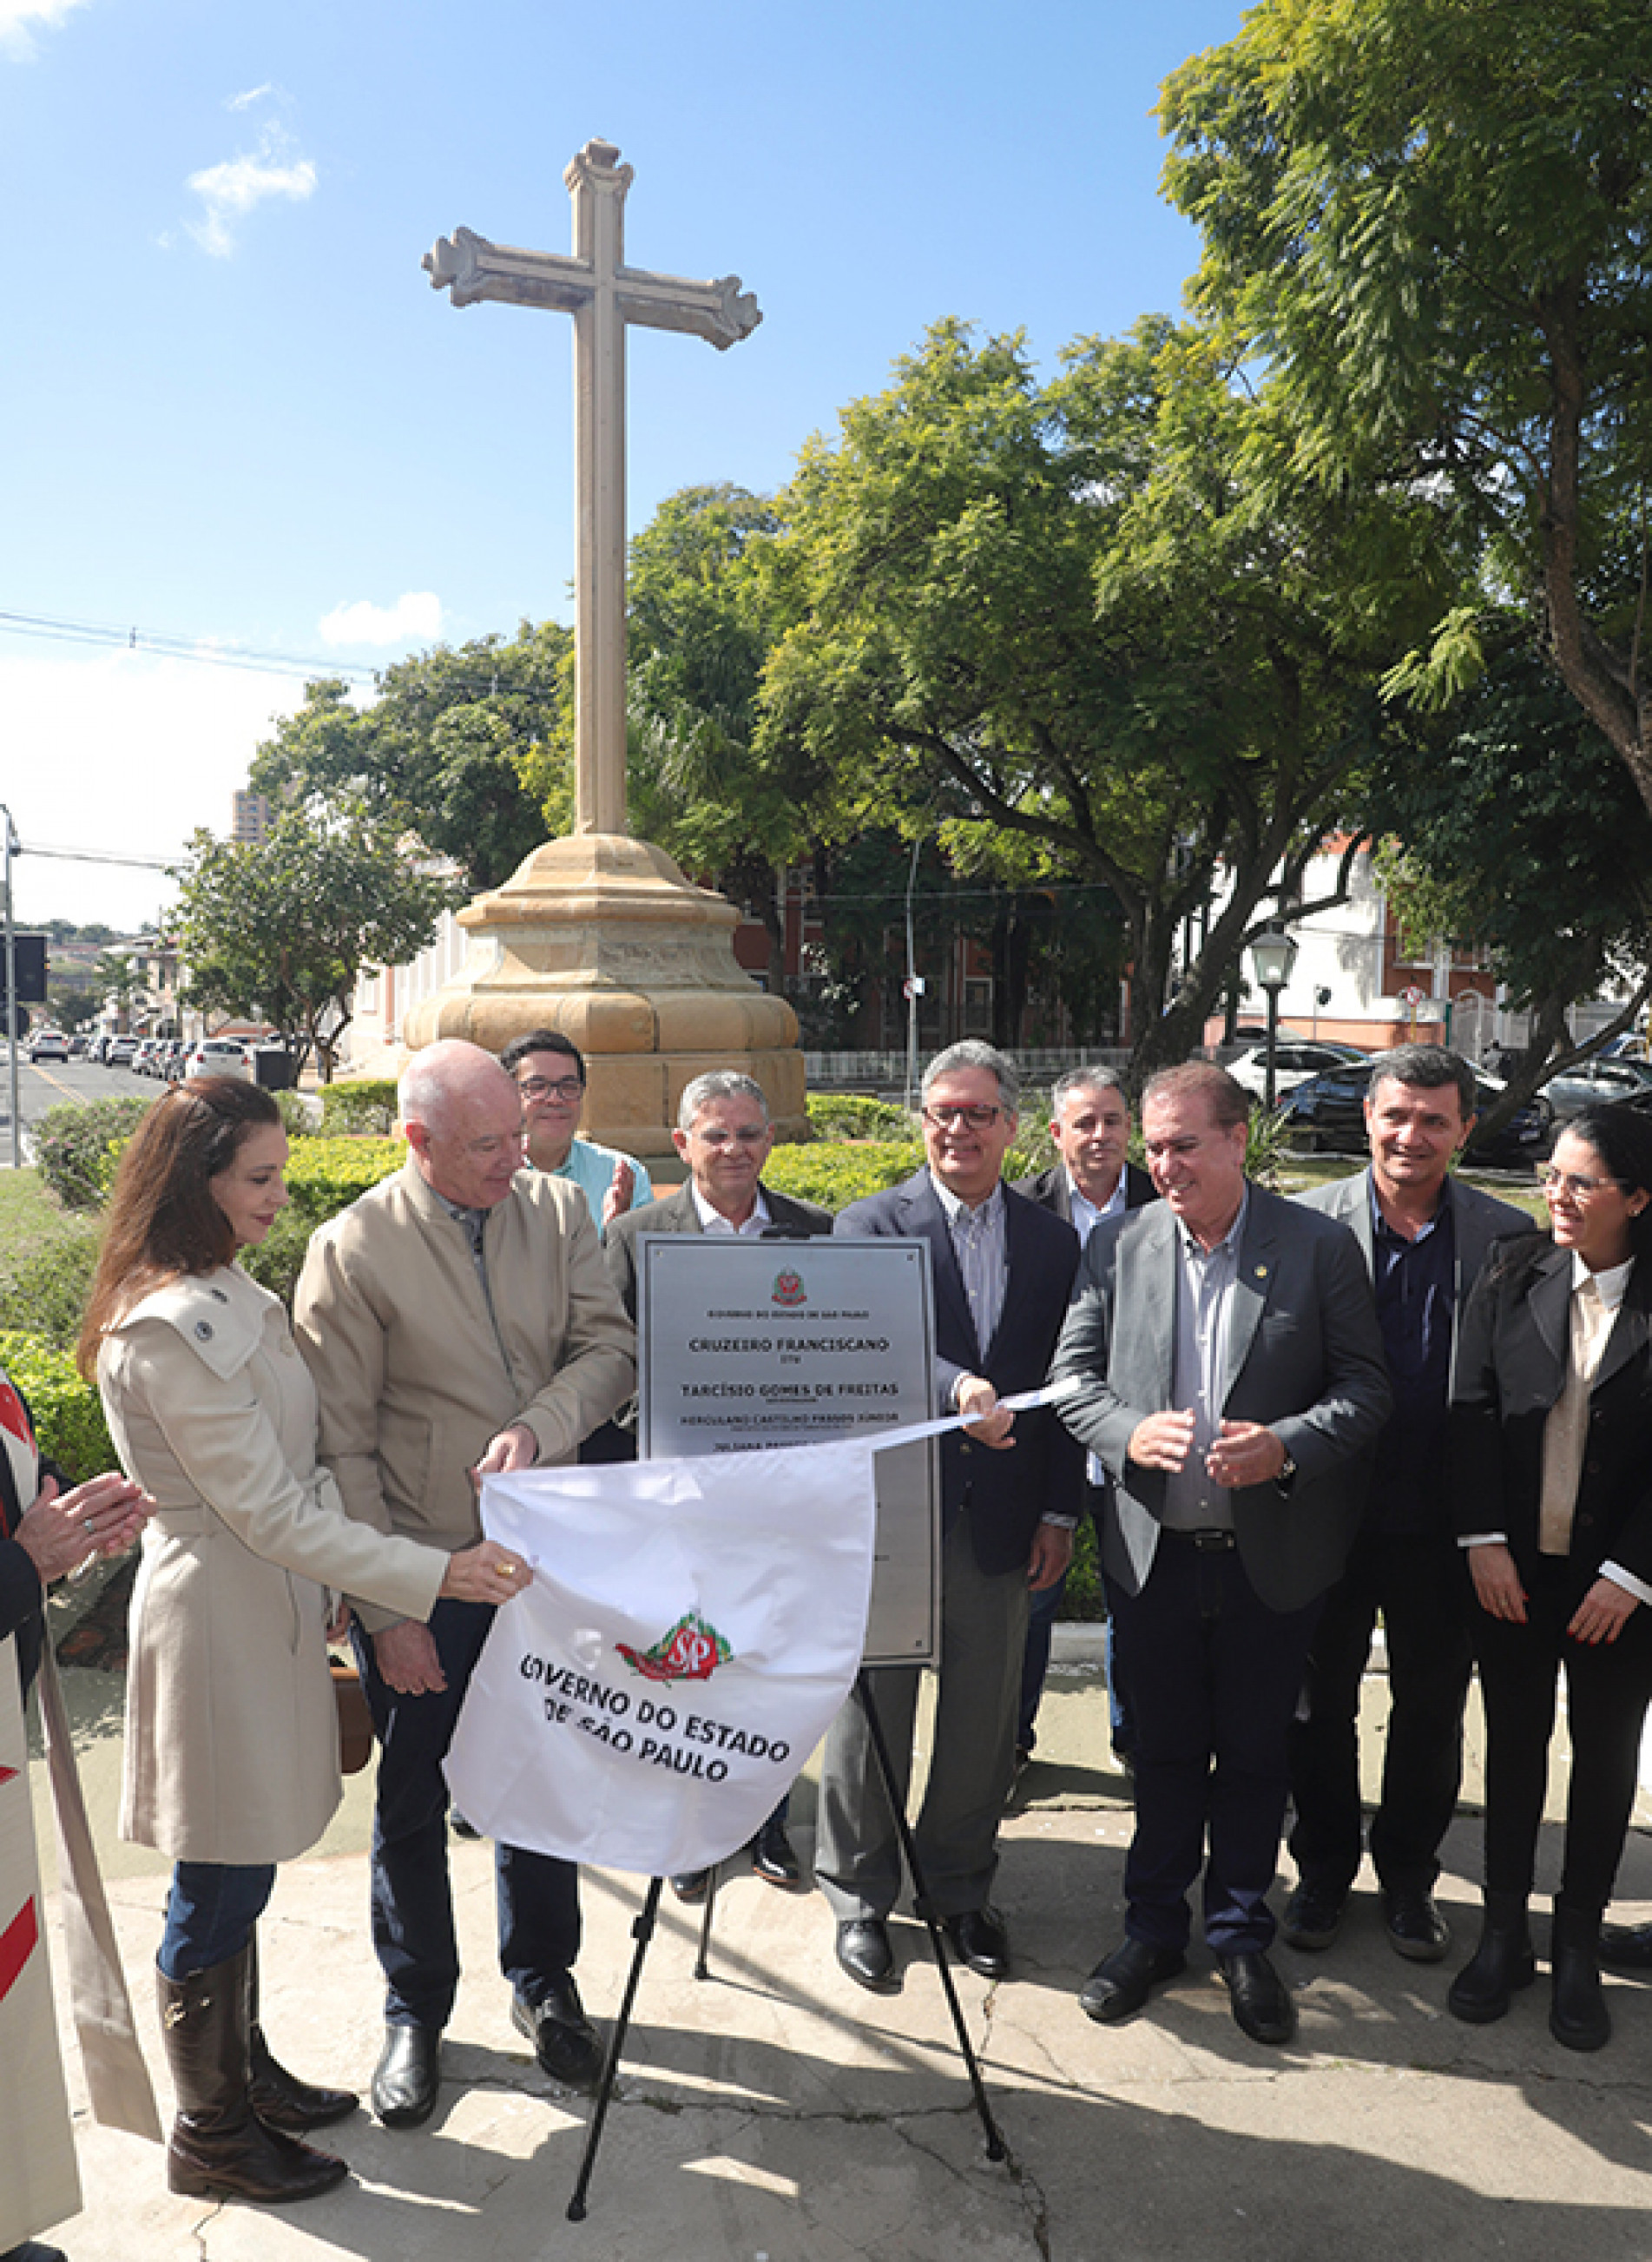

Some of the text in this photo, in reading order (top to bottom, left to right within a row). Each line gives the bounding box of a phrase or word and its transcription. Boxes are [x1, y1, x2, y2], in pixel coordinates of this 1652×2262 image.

[688, 1338, 890, 1353] CRUZEIRO FRANCISCANO
[681, 1381, 899, 1397] TARCÍSIO GOMES DE FREITAS
[668, 1632, 711, 1672] SP
[636, 1698, 677, 1731] DO
[683, 1713, 790, 1763] ESTADO
[638, 1737, 729, 1783] PAULO
